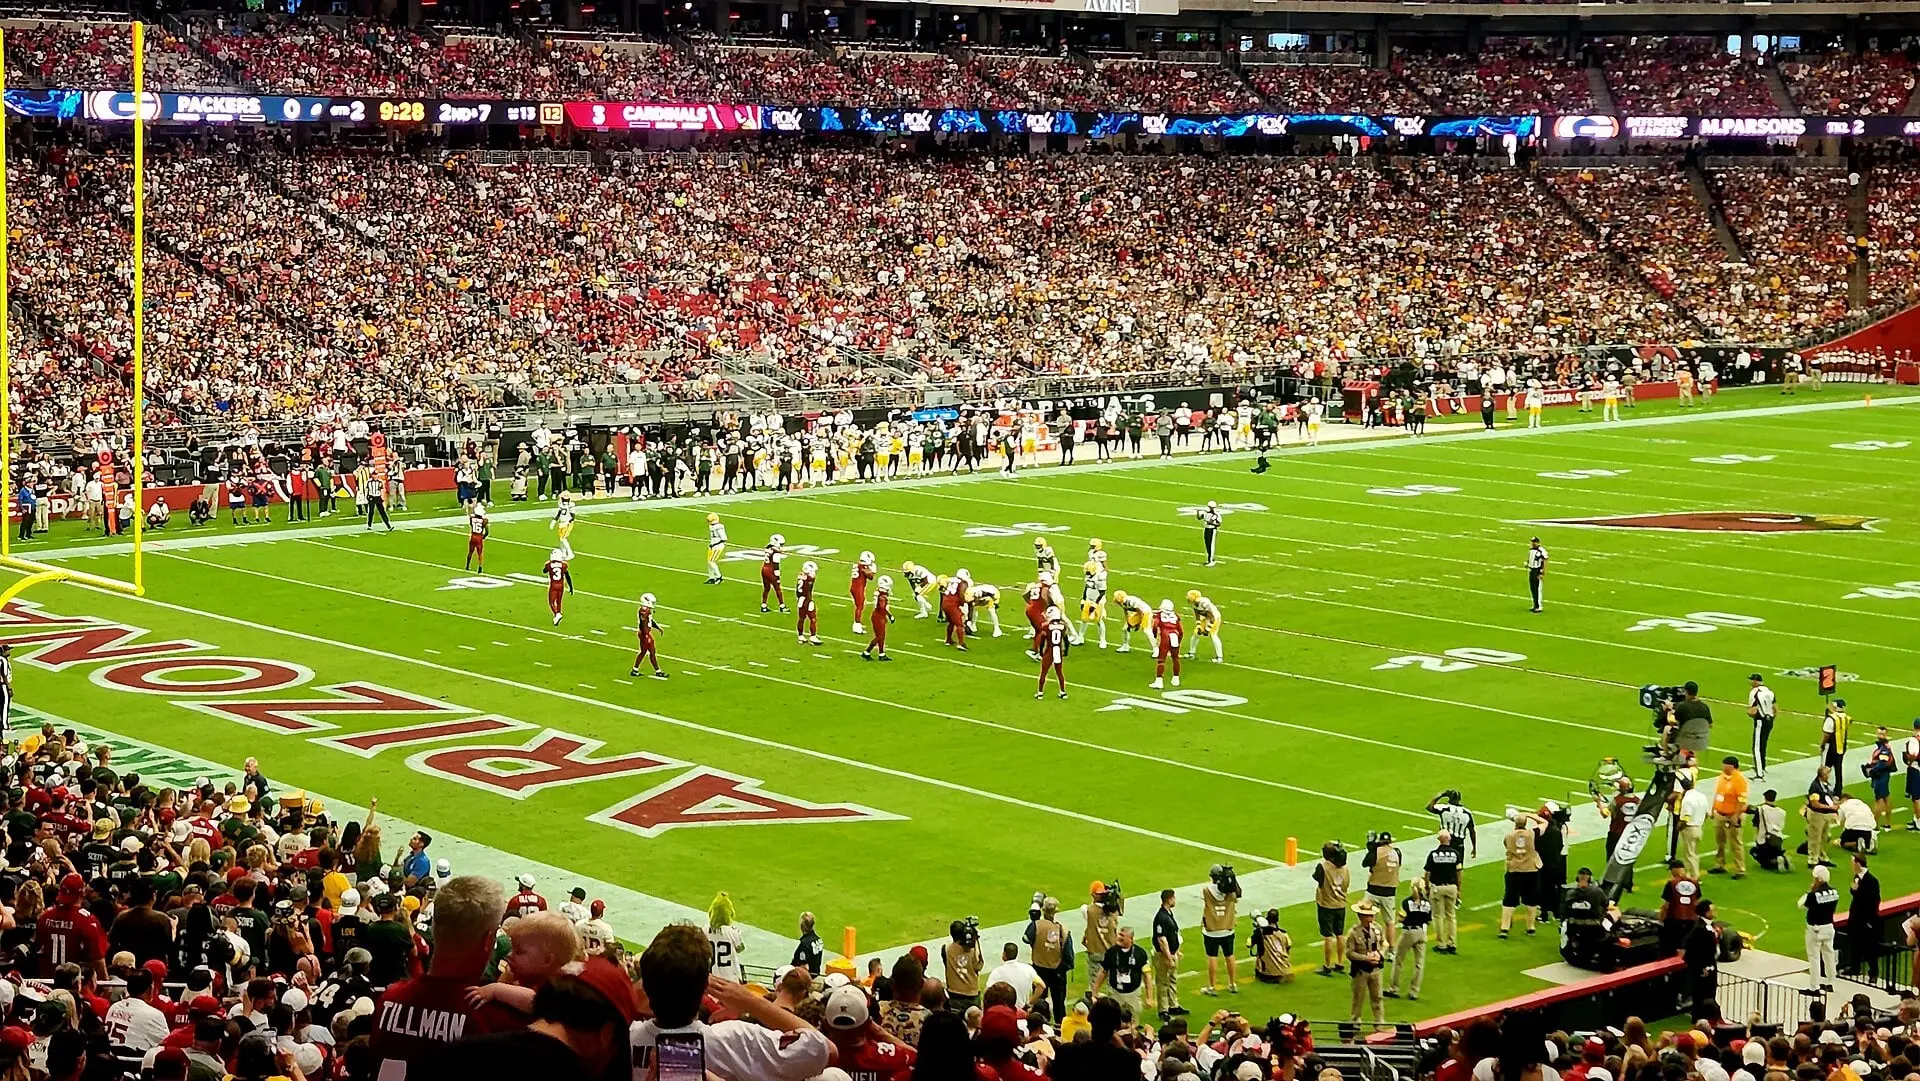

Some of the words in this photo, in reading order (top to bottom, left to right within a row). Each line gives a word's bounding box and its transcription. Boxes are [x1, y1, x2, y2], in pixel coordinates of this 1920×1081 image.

[178, 96, 261, 113] PACKERS
[283, 98, 300, 119] 0
[350, 101, 365, 121] 2
[379, 101, 425, 121] 9:28
[544, 107, 561, 120] 12
[622, 105, 708, 122] CARDINALS
[592, 105, 606, 125] 3
[1700, 118, 1806, 136] M.PARSONS
[1852, 119, 1866, 135] 2
[301, 448, 312, 461] 2
[472, 521, 484, 534] 16
[552, 567, 562, 581] 3
[1637, 612, 1766, 632] 30
[1051, 629, 1062, 646] 0
[1387, 648, 1527, 673] 20
[1823, 668, 1834, 688] 2
[1111, 690, 1249, 713] 10
[1620, 825, 1643, 853] FOX
[50, 933, 66, 964] 11
[711, 941, 731, 967] 2
[379, 1001, 467, 1042] TILLMAN
